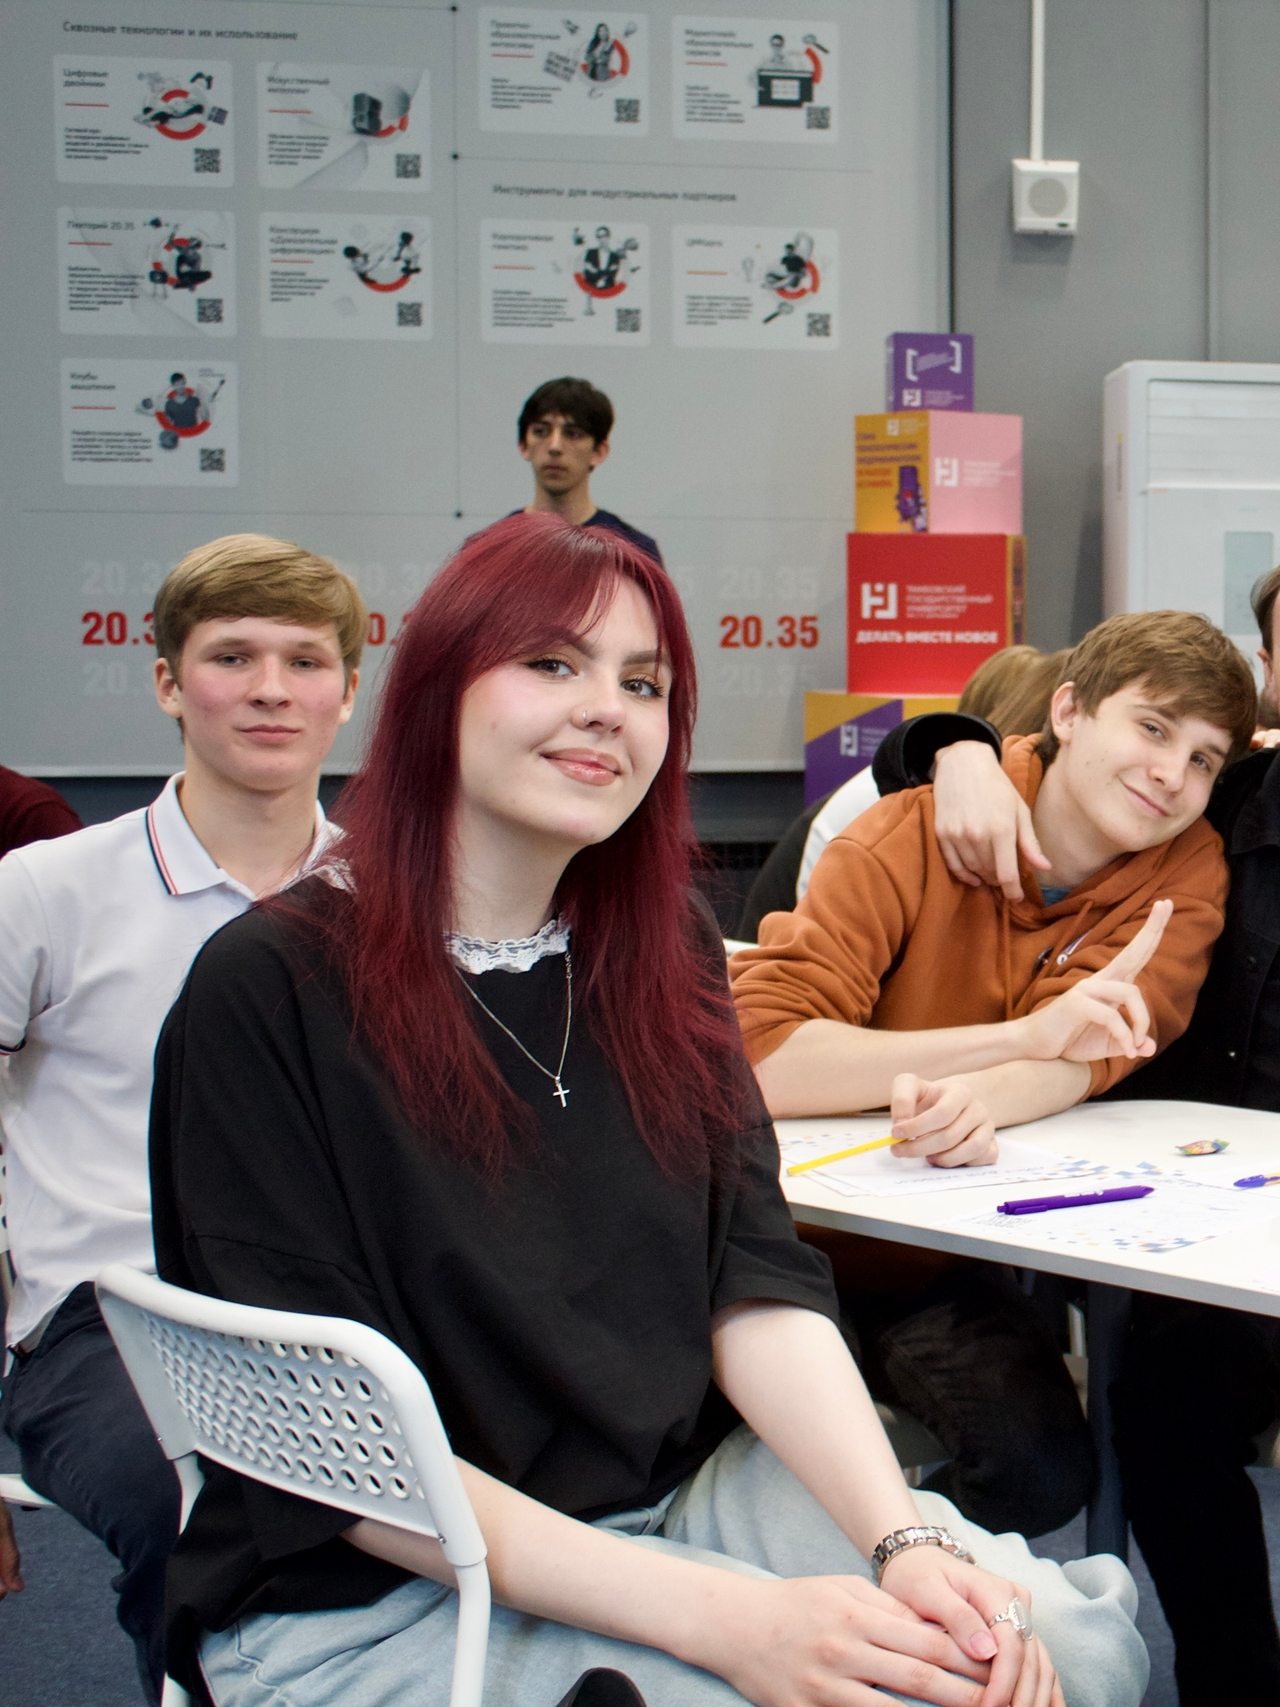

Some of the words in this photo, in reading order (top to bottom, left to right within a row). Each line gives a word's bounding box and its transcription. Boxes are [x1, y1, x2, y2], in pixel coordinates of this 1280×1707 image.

[63, 21, 117, 33] Сквозные
[120, 26, 184, 36] технологии
[215, 30, 298, 40] использование
[82, 611, 157, 646] 20.3
[719, 615, 819, 648] 20.35
